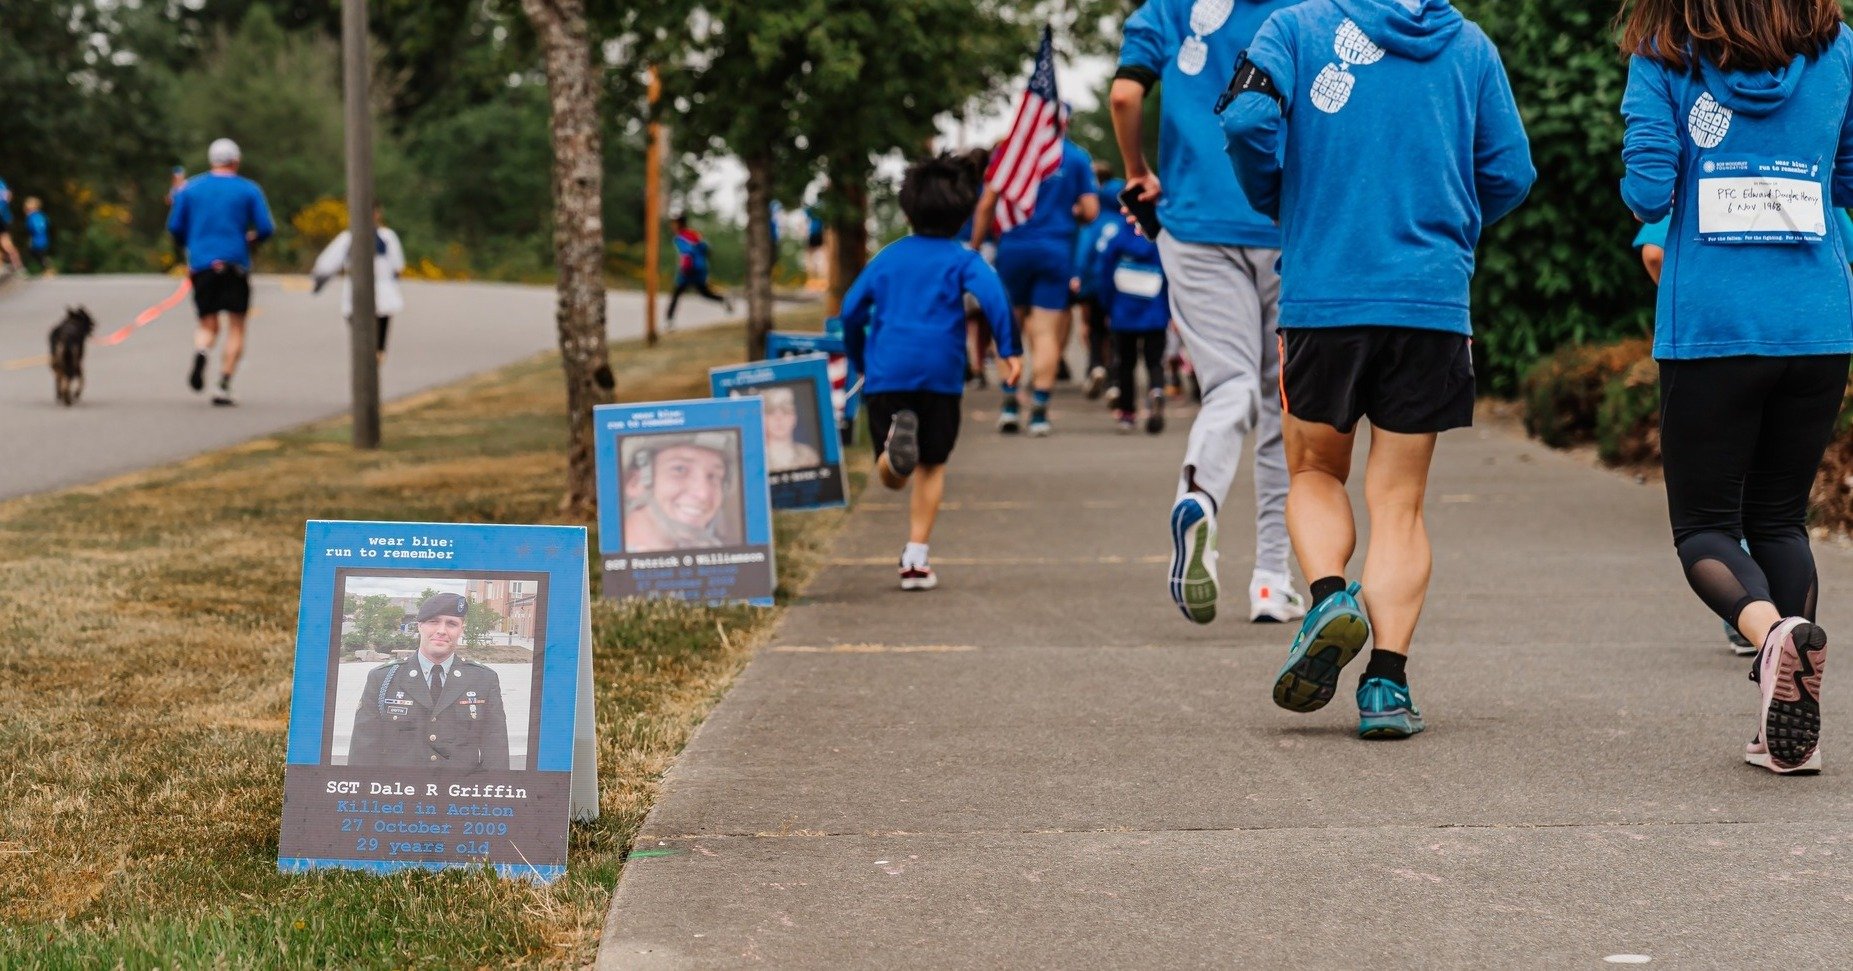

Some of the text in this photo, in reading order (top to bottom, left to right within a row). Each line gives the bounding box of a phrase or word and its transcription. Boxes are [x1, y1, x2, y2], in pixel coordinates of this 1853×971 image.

[1717, 188, 1737, 200] PFC
[1743, 188, 1772, 199] Edward
[1727, 202, 1782, 214] 6 Nov 1968
[368, 536, 454, 547] wear blue:
[326, 547, 454, 559] run to remember
[326, 781, 527, 799] SGT Dale R Griffin
[336, 800, 514, 817] Killed in Action
[341, 818, 508, 836] 27 October 2009
[356, 838, 491, 855] 29 years old
